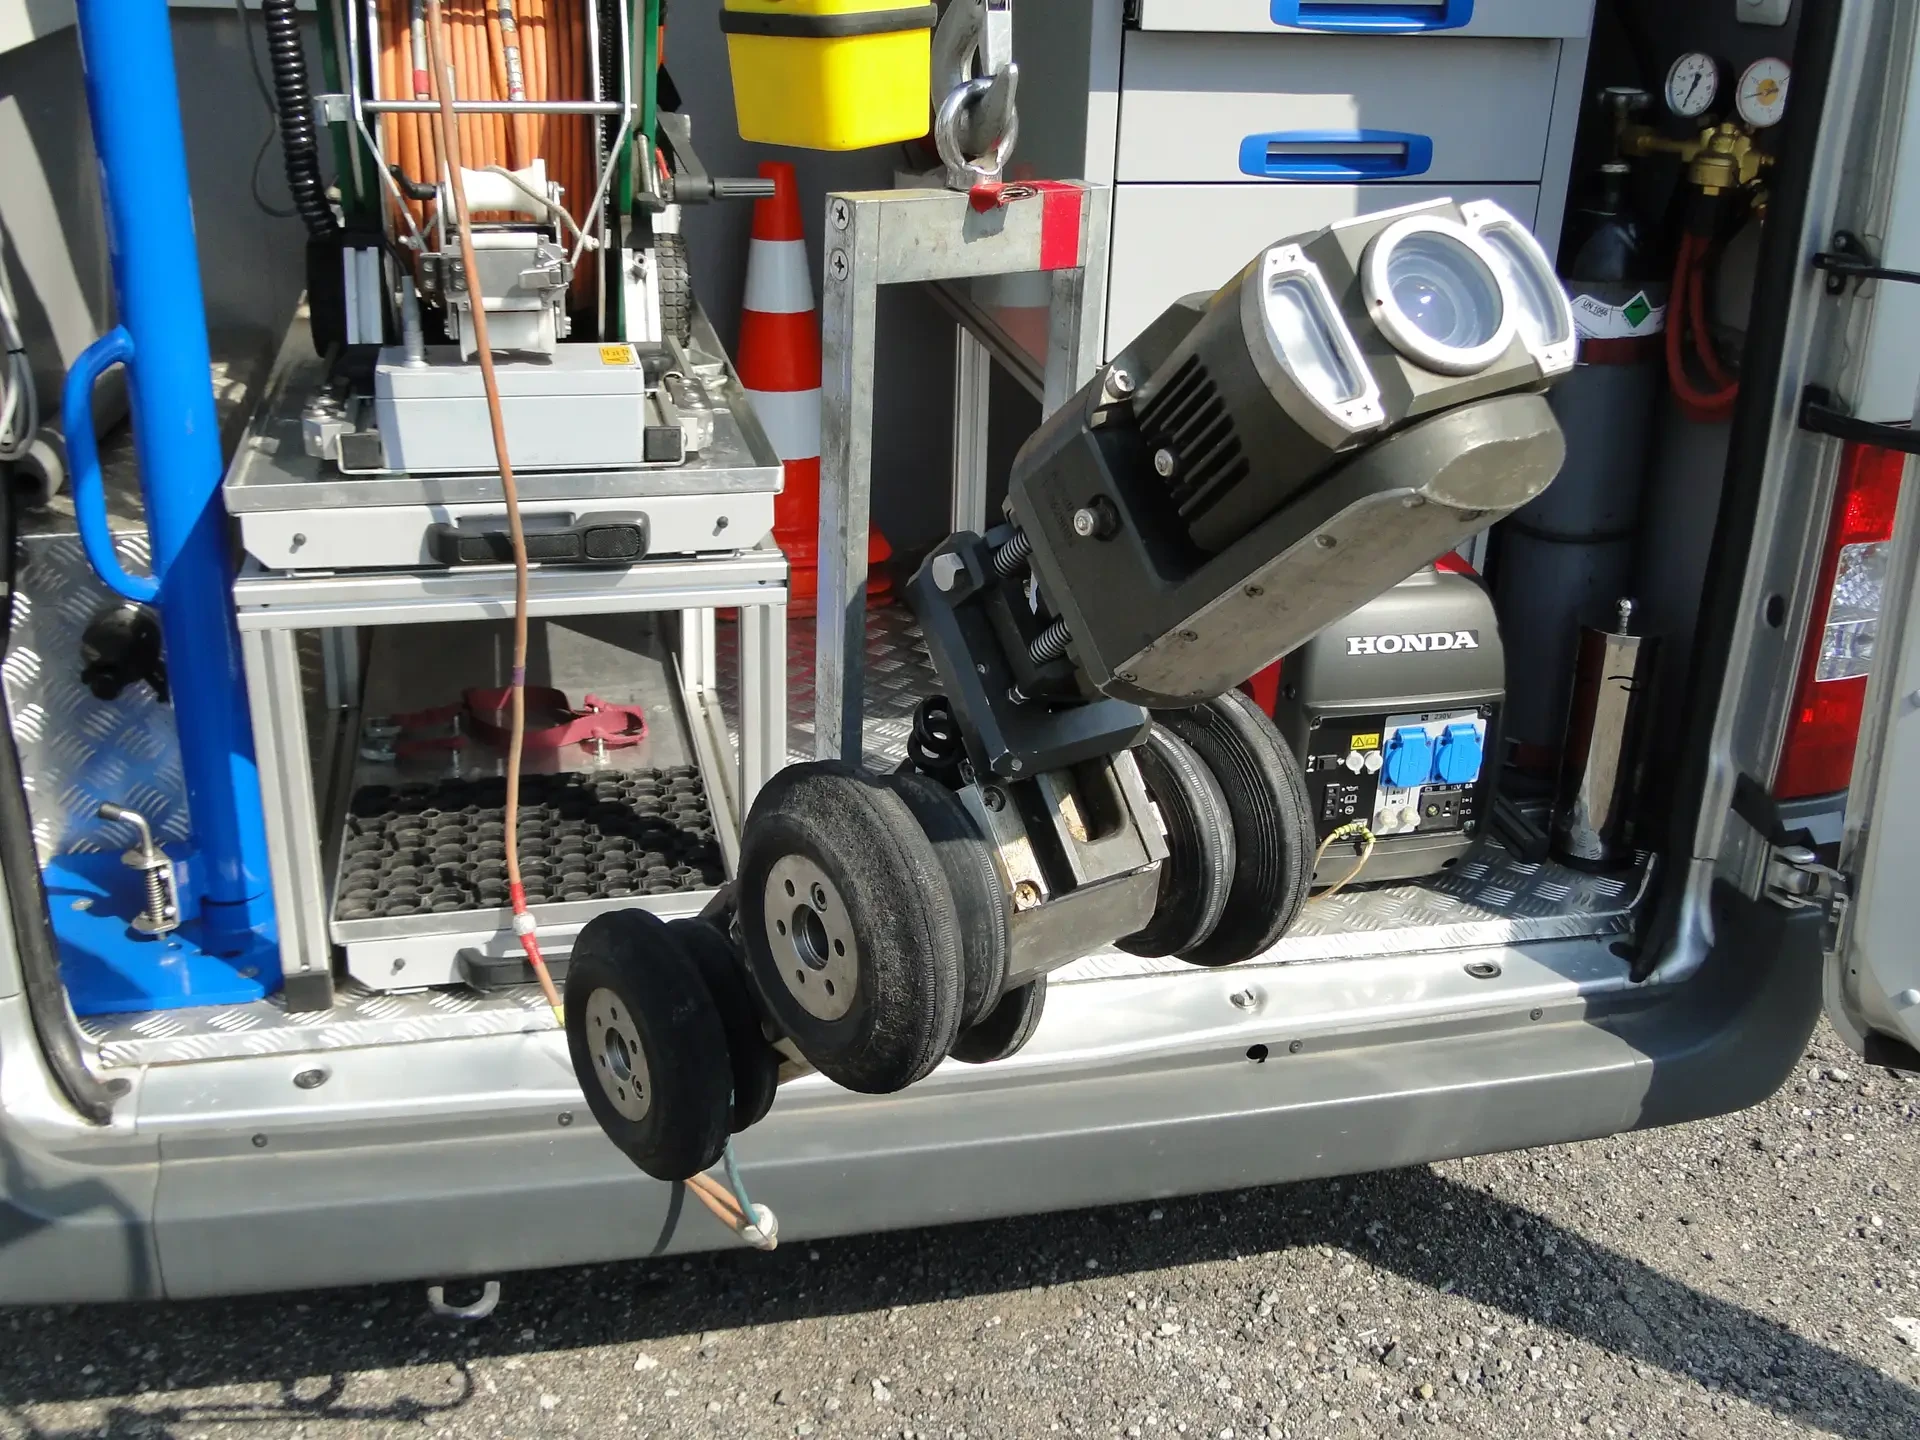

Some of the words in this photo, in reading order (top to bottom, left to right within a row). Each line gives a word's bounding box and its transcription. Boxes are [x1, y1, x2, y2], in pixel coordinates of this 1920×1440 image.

[1583, 301, 1593, 310] UN
[1346, 631, 1479, 655] HONDA
[1434, 712, 1452, 720] 230V
